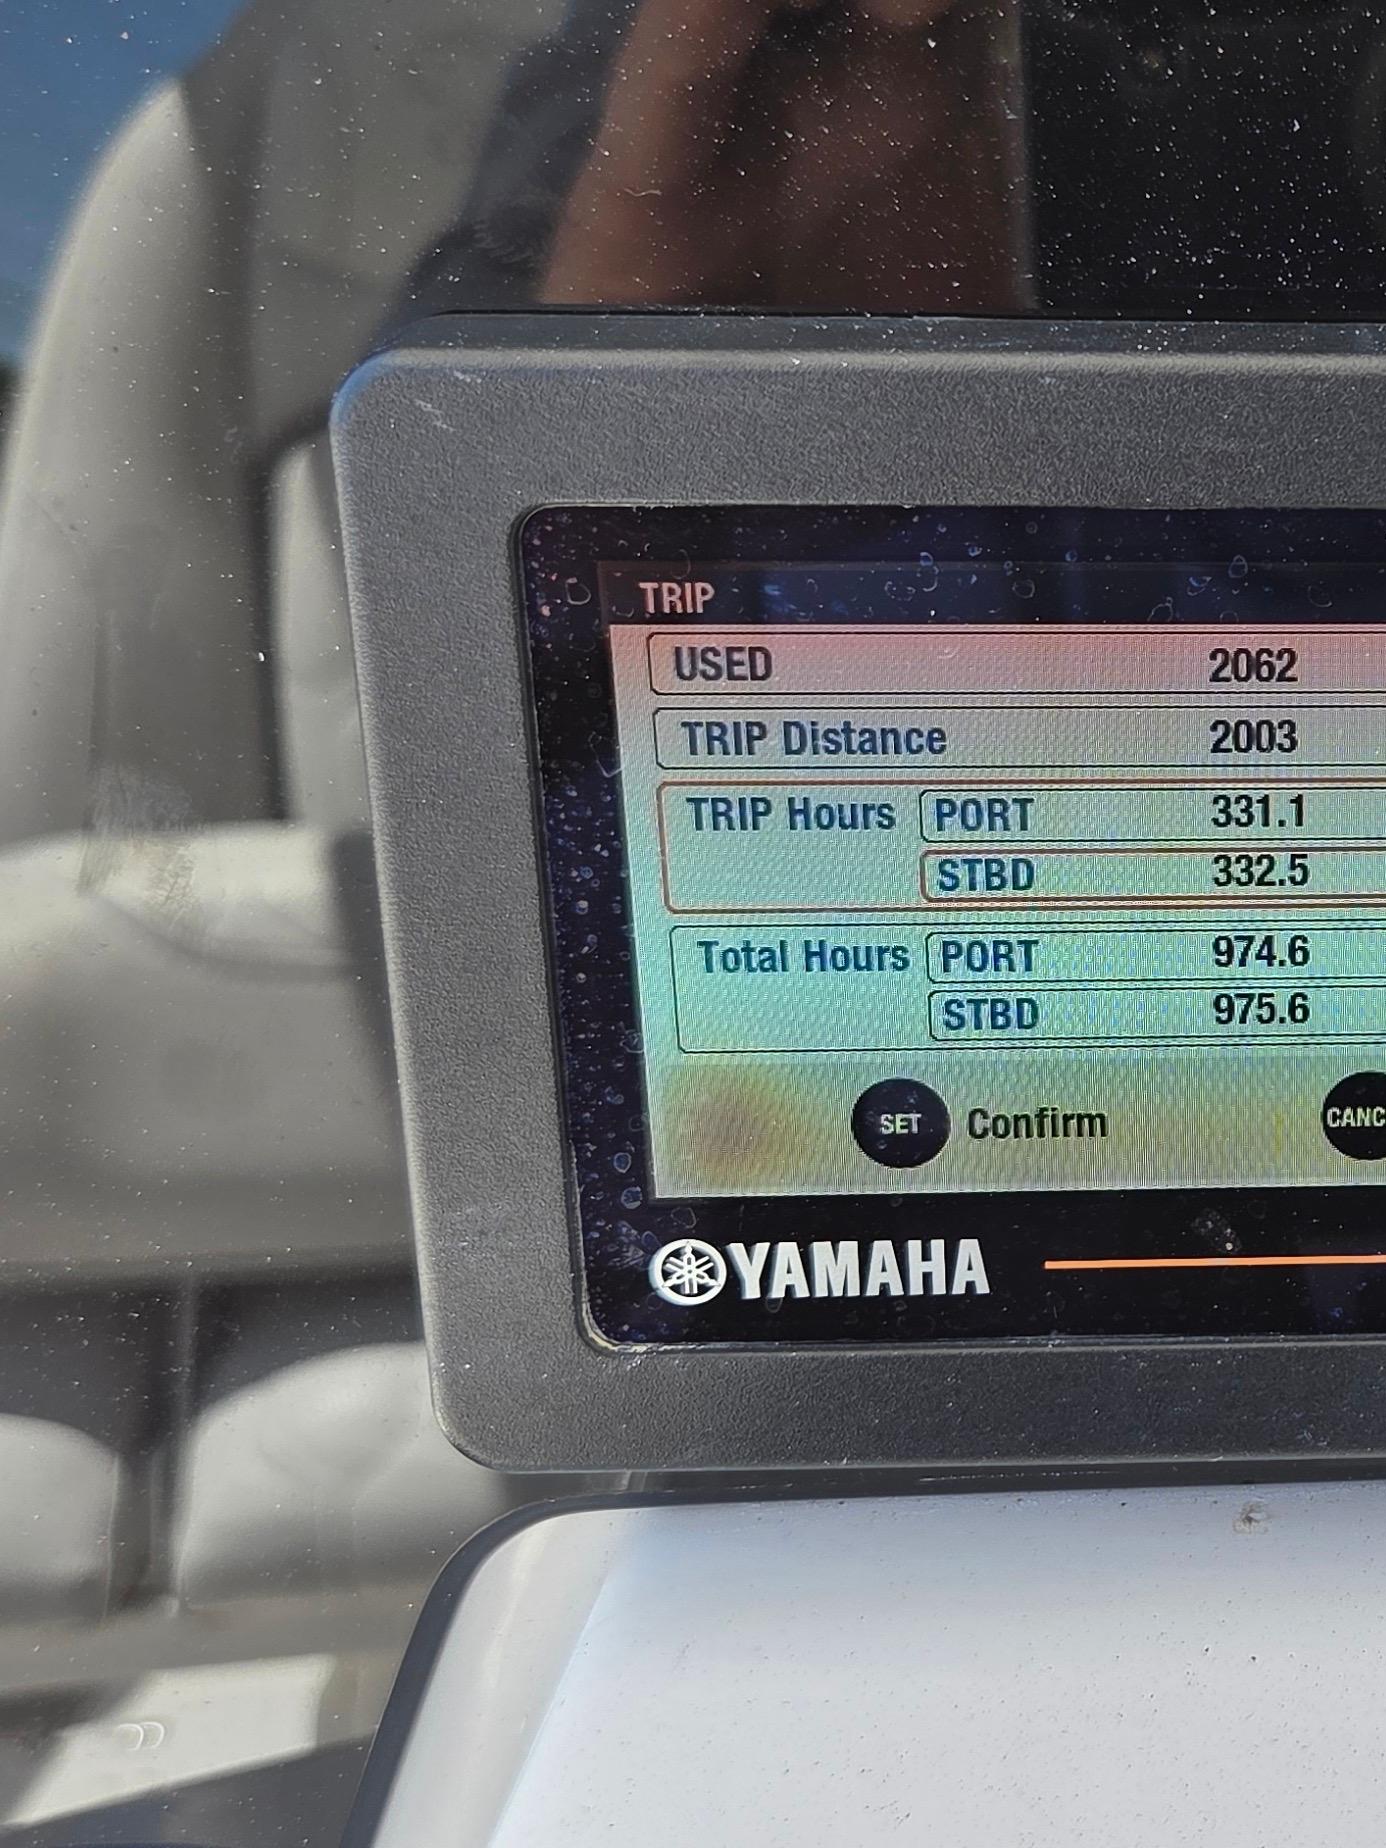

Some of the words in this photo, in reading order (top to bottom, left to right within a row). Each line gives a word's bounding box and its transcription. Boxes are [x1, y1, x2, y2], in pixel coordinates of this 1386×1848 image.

[639, 581, 715, 614] TRIP
[674, 645, 773, 681] USED
[1208, 648, 1299, 683] 2062
[681, 721, 767, 756] TRIP
[783, 721, 948, 756] Distance
[1209, 720, 1299, 753] 2003
[686, 797, 771, 831] TRIP
[787, 797, 897, 831] Hours
[936, 798, 1035, 832] PORT
[1211, 794, 1305, 828] 331.1
[937, 859, 1035, 892] STBD
[1212, 854, 1310, 887] 332.5
[697, 939, 789, 973] Total
[803, 939, 911, 972] Hours
[941, 940, 1039, 973] PORT
[1212, 935, 1310, 968] 974.6
[942, 998, 1040, 1031] STBD
[1212, 992, 1310, 1025] 975.6
[879, 1113, 922, 1135] SET
[967, 1108, 1108, 1140] Confirm
[725, 1238, 991, 1300] YAMAHA
